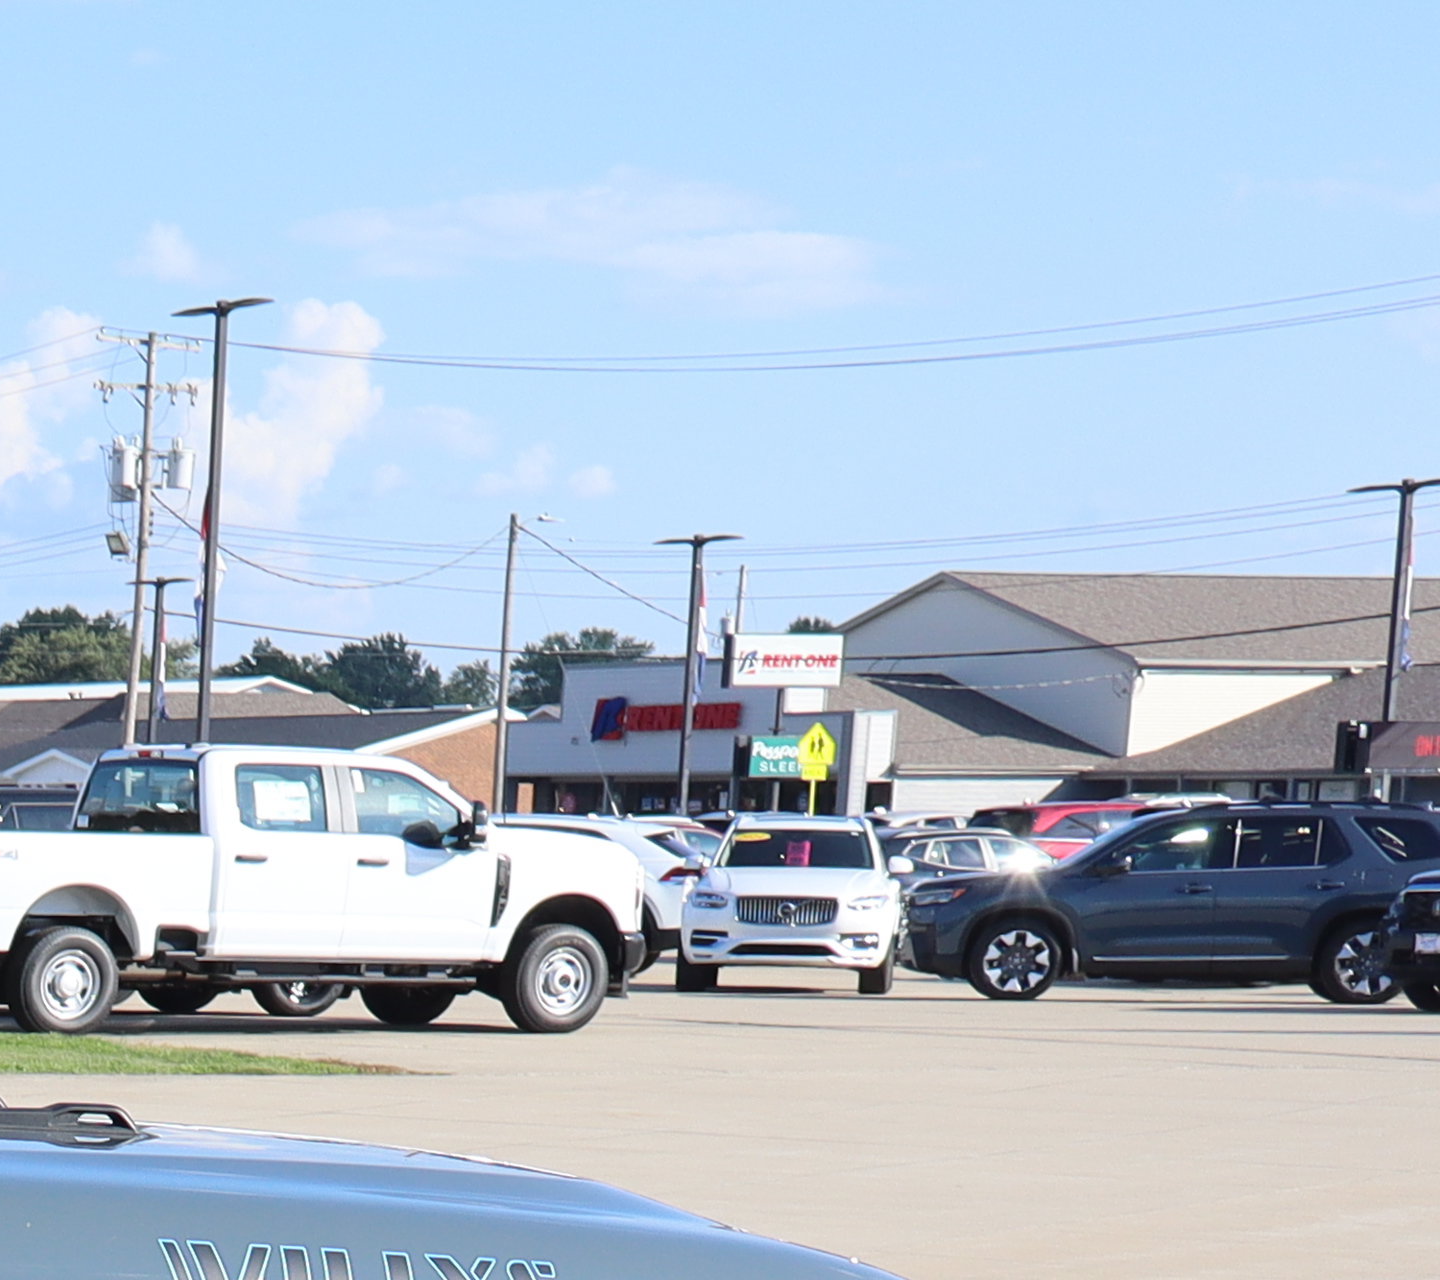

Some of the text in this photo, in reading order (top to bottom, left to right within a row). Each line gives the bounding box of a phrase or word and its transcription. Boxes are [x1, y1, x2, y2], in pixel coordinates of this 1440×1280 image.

[762, 654, 838, 669] RENT ONE
[626, 705, 684, 731] RENT
